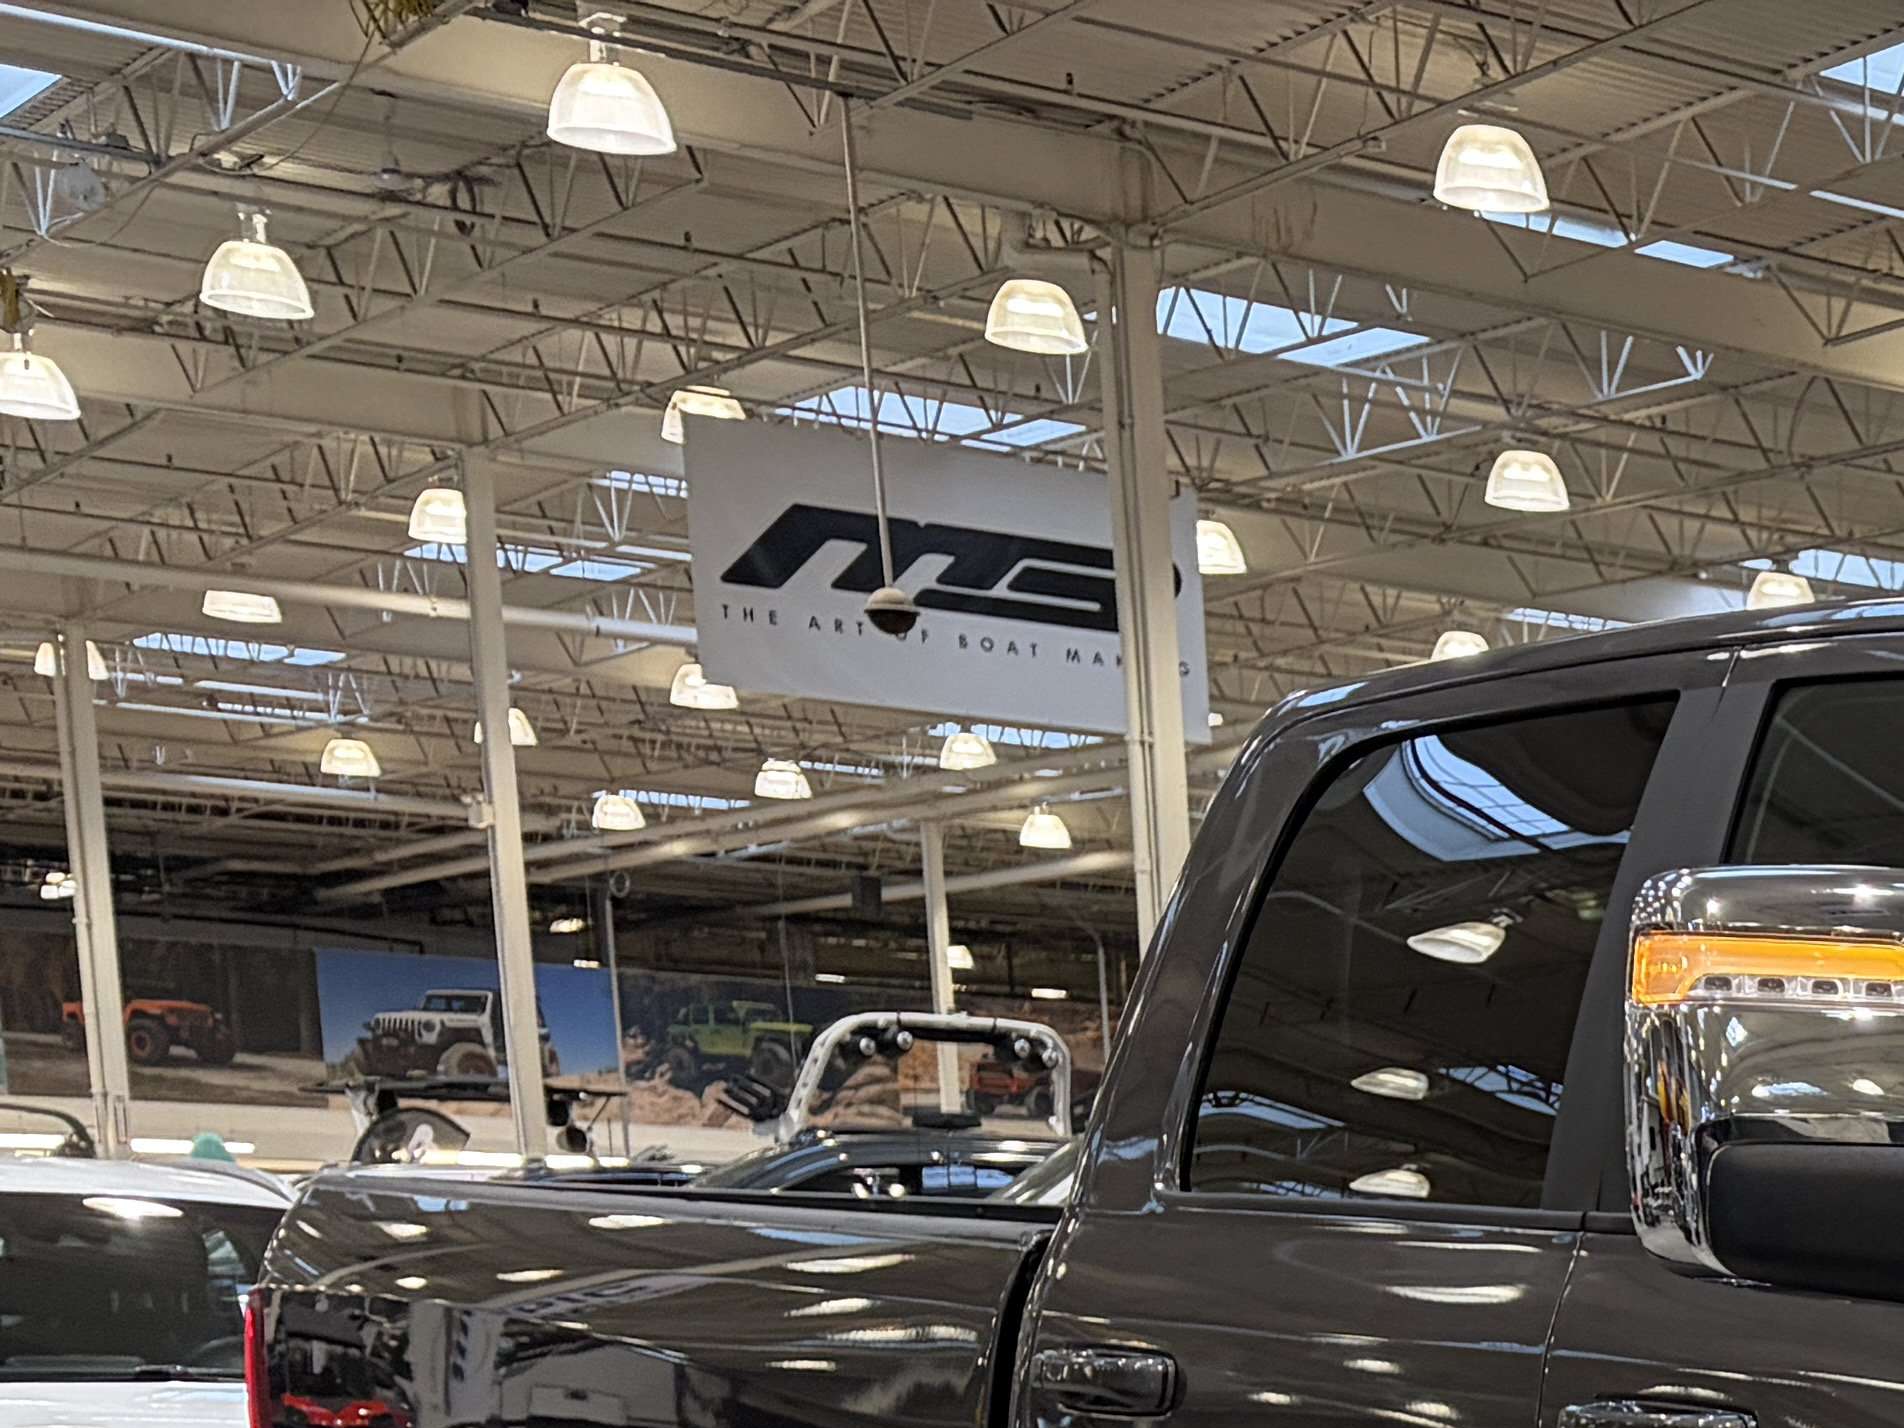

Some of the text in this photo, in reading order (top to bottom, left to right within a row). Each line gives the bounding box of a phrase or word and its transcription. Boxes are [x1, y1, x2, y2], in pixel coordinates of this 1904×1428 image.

[722, 604, 777, 626] THE
[808, 616, 864, 636] ART
[958, 633, 1037, 658] BOAT
